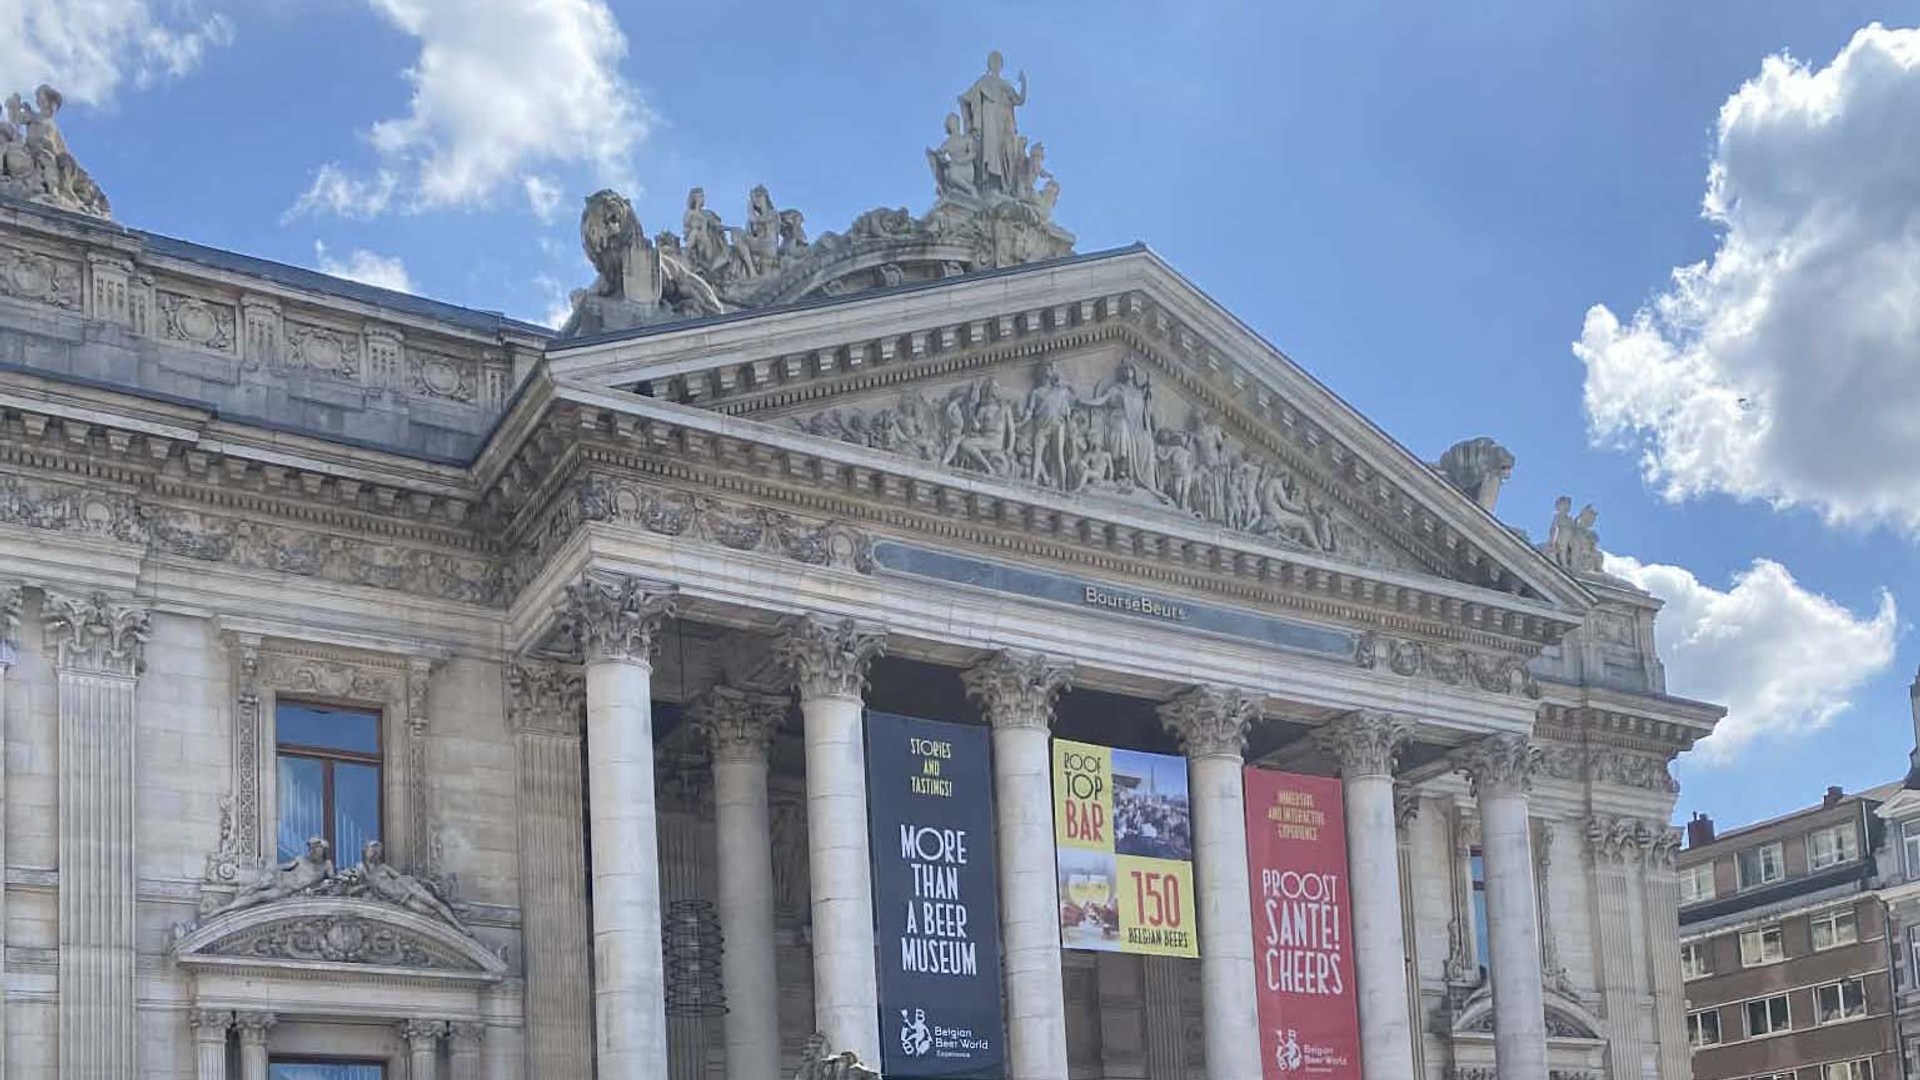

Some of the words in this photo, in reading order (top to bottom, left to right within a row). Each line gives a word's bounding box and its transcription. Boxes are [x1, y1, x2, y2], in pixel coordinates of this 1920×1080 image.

[910, 737, 952, 759] STORIES
[1064, 752, 1102, 774] ROOF
[923, 758, 940, 776] AND
[911, 775, 952, 797] TASTINGS!
[1064, 771, 1103, 801] TOP
[1065, 799, 1104, 843] BAR
[900, 824, 967, 864] MORE
[911, 863, 958, 900] THAN
[1262, 868, 1338, 903] PROOST
[1131, 870, 1181, 928] 150
[906, 900, 918, 933] A
[923, 901, 967, 938] BEER
[1128, 927, 1162, 946] BELGIAN
[1164, 929, 1190, 949] BEERS
[901, 937, 977, 976] MUSEUM
[1266, 948, 1343, 995] CHEERS
[934, 1026, 972, 1039] Belgian
[936, 1037, 959, 1049] Beer
[960, 1038, 989, 1050] World
